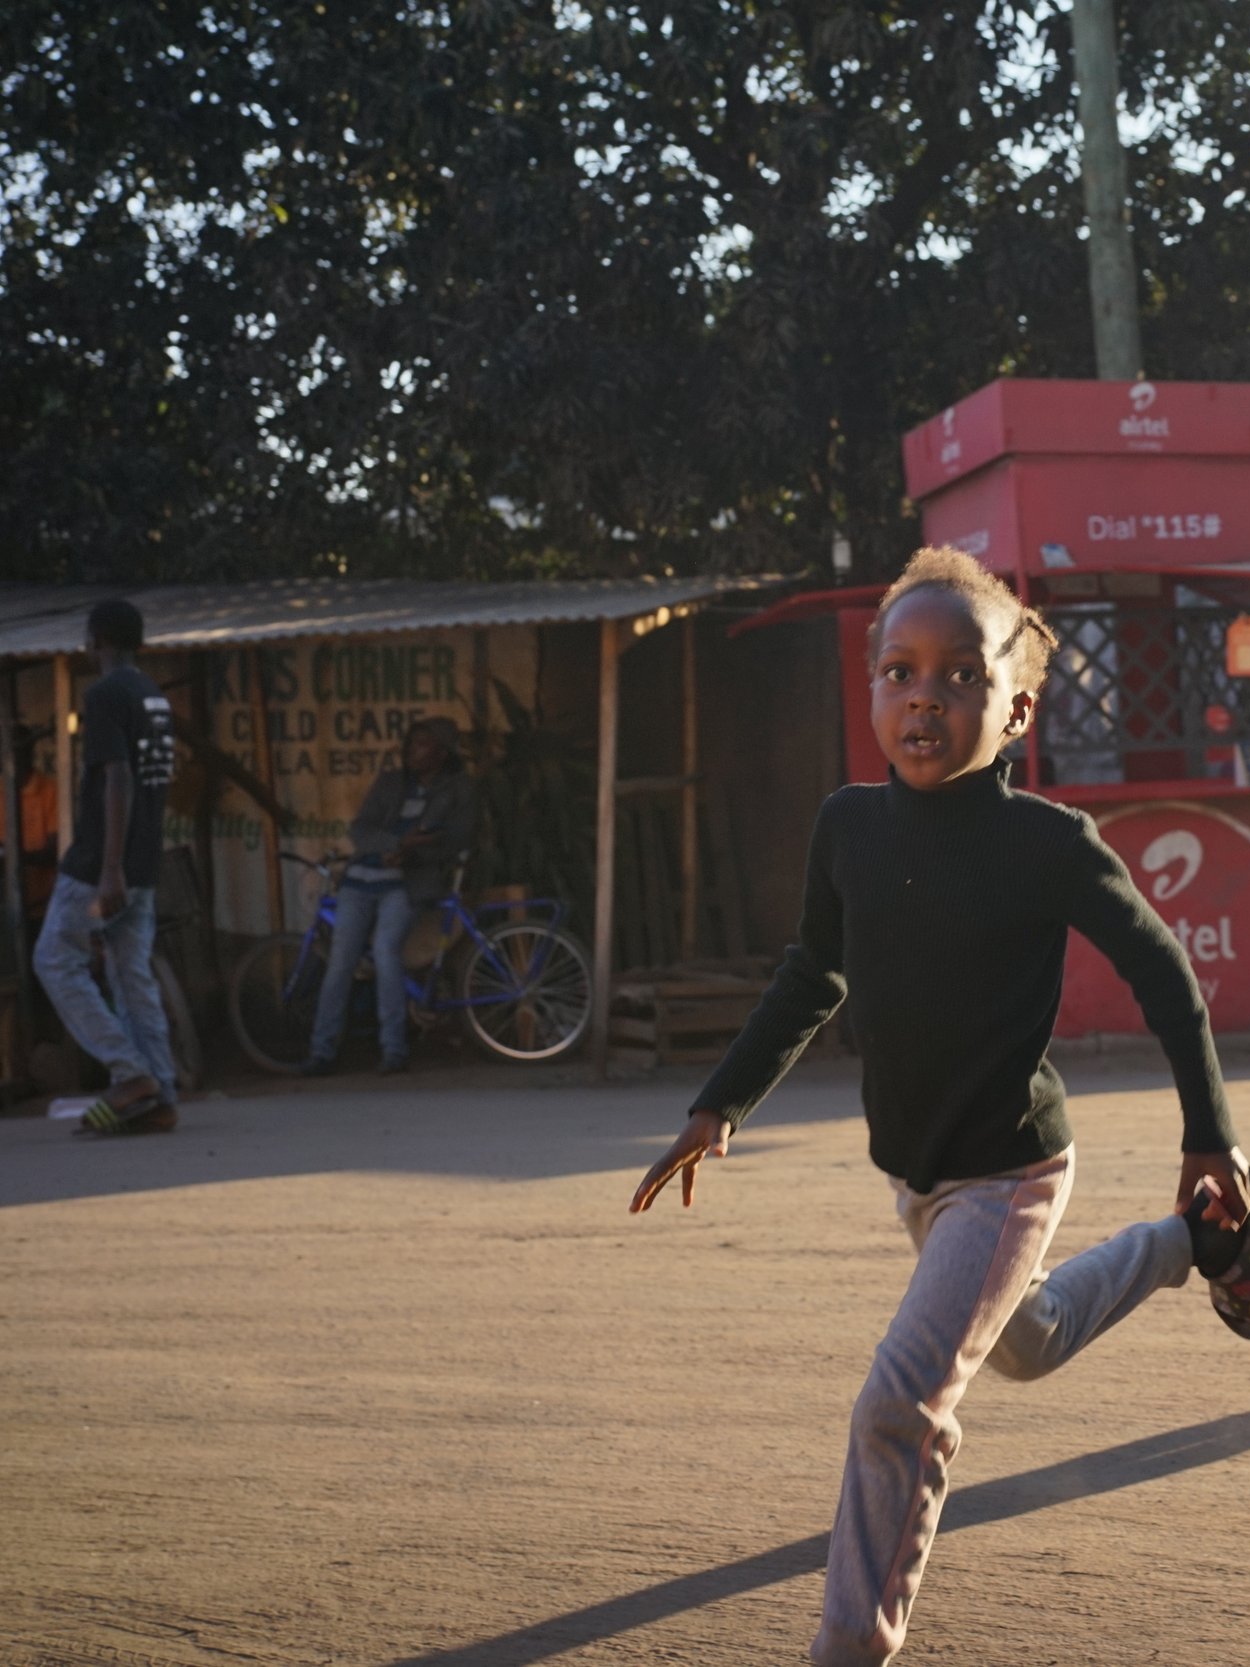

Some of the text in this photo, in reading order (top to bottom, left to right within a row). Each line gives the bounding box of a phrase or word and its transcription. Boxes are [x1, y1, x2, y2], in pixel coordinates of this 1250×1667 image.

[1119, 415, 1170, 436] airtel
[1088, 515, 1136, 541] Dial
[312, 645, 455, 703] CORNER
[232, 710, 316, 742] CILD
[329, 750, 402, 775] ESTA
[1172, 916, 1237, 962] tel
